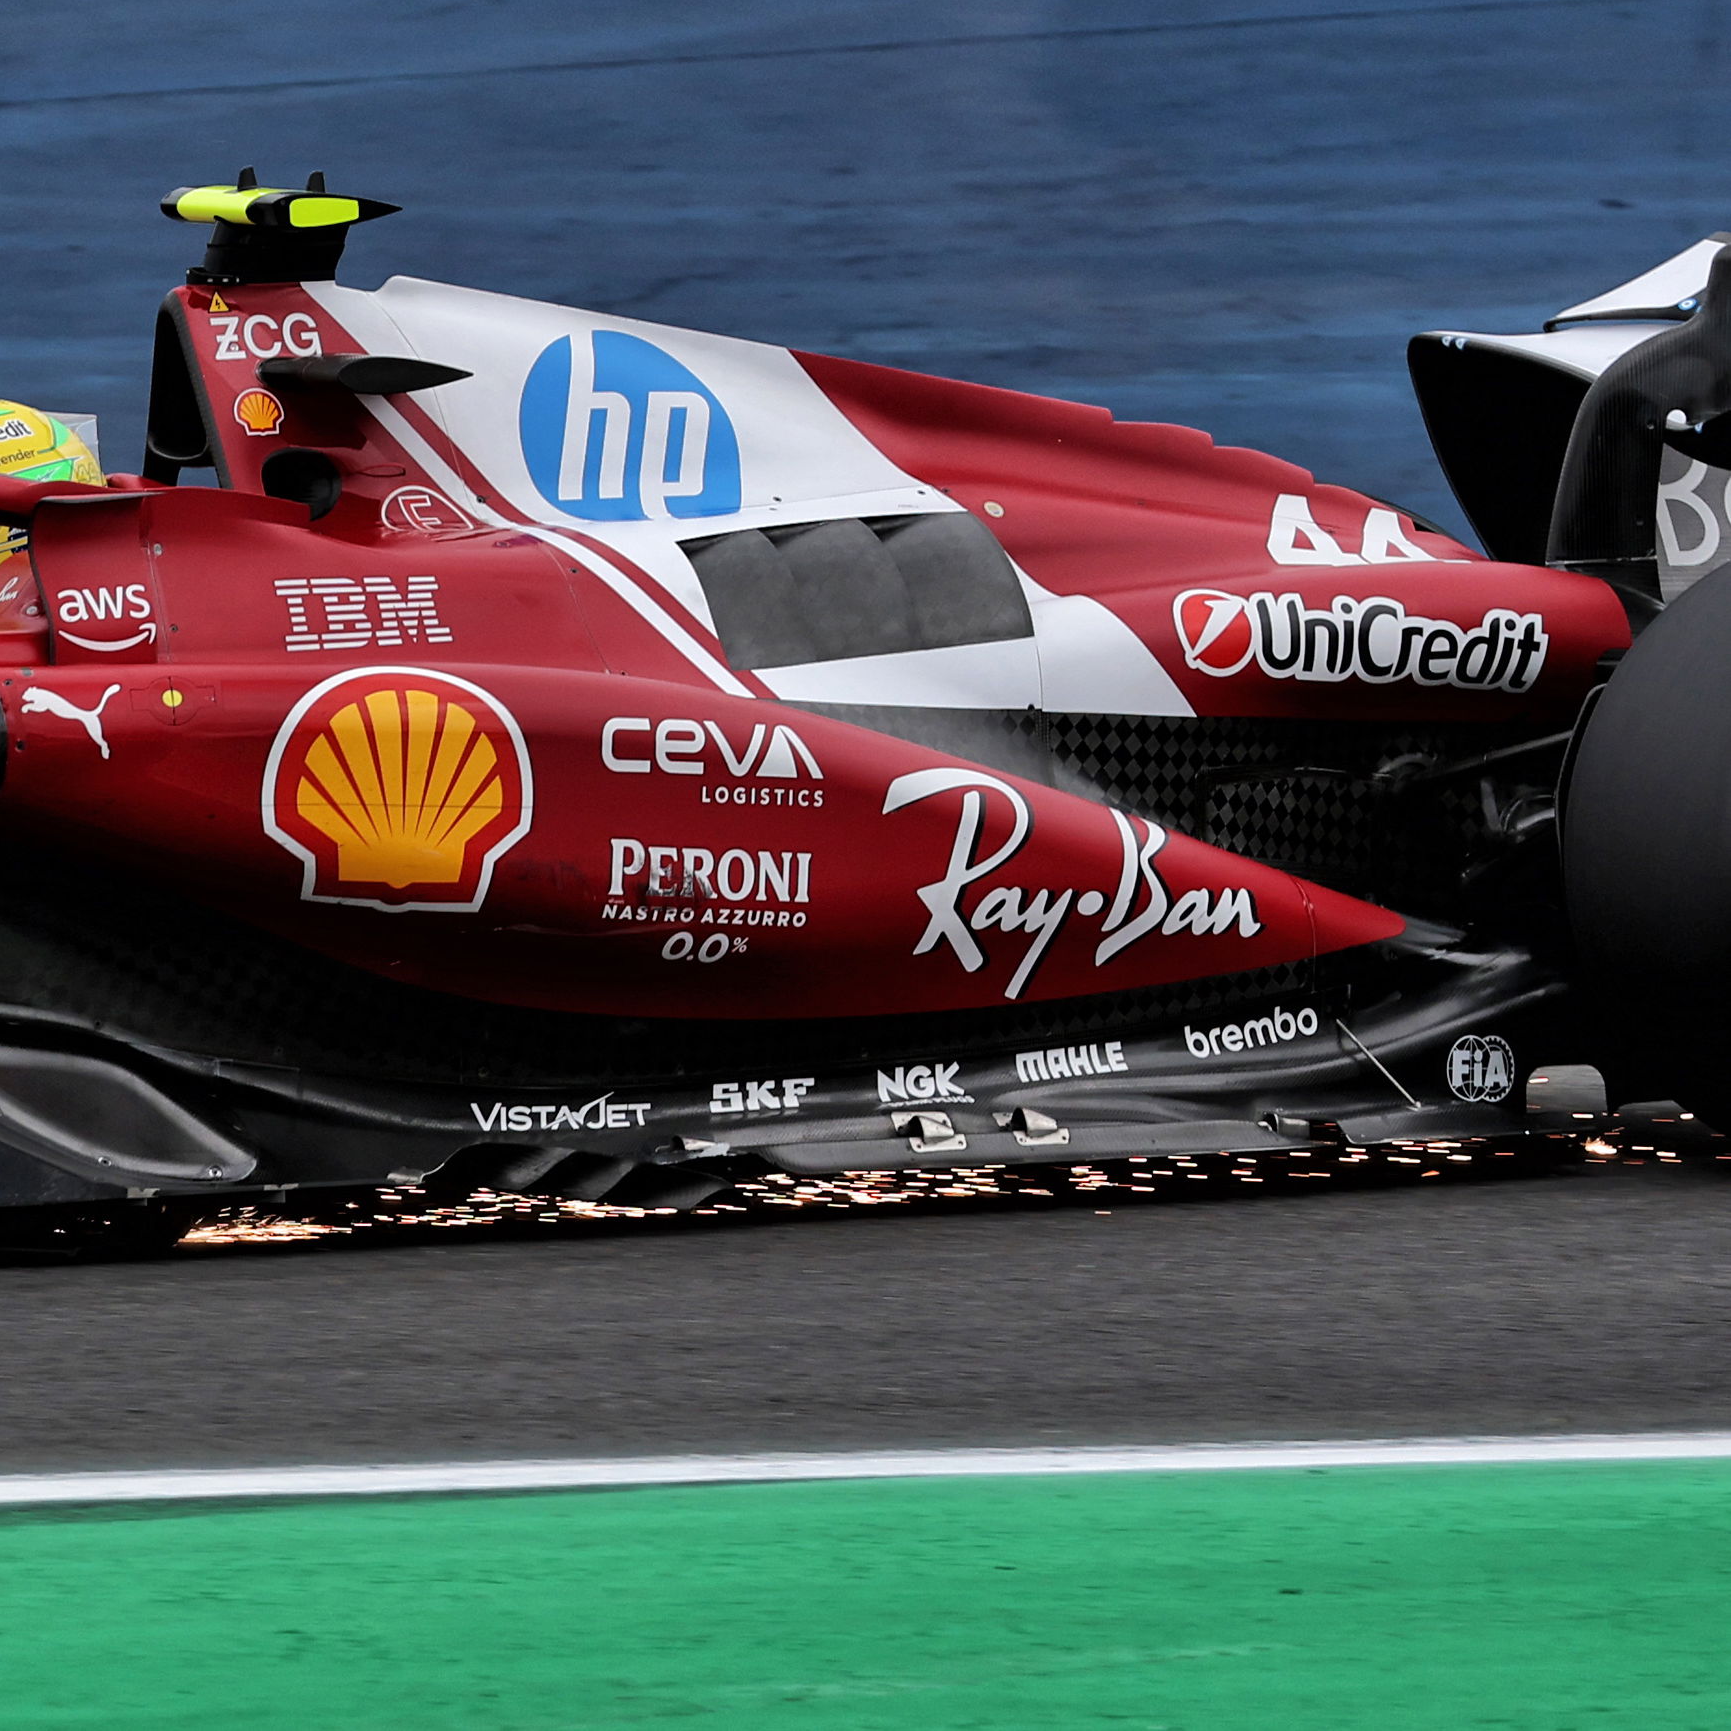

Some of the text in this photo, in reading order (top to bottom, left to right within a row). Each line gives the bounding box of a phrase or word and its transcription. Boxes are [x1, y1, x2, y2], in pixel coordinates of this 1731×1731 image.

[558, 330, 711, 520] hp
[57, 584, 151, 623] aws
[274, 575, 454, 652] IBM
[1255, 597, 1547, 692] UniCredit
[701, 786, 824, 808] LOGISTICS
[608, 837, 813, 903] PERONI
[602, 904, 807, 928] NASTRO AZZURRO
[661, 931, 750, 964] 0.0%
[1183, 1006, 1318, 1058] brembo
[877, 1060, 965, 1103] NGK
[1015, 1041, 1128, 1083] MAHLE
[709, 1077, 815, 1113] SKF
